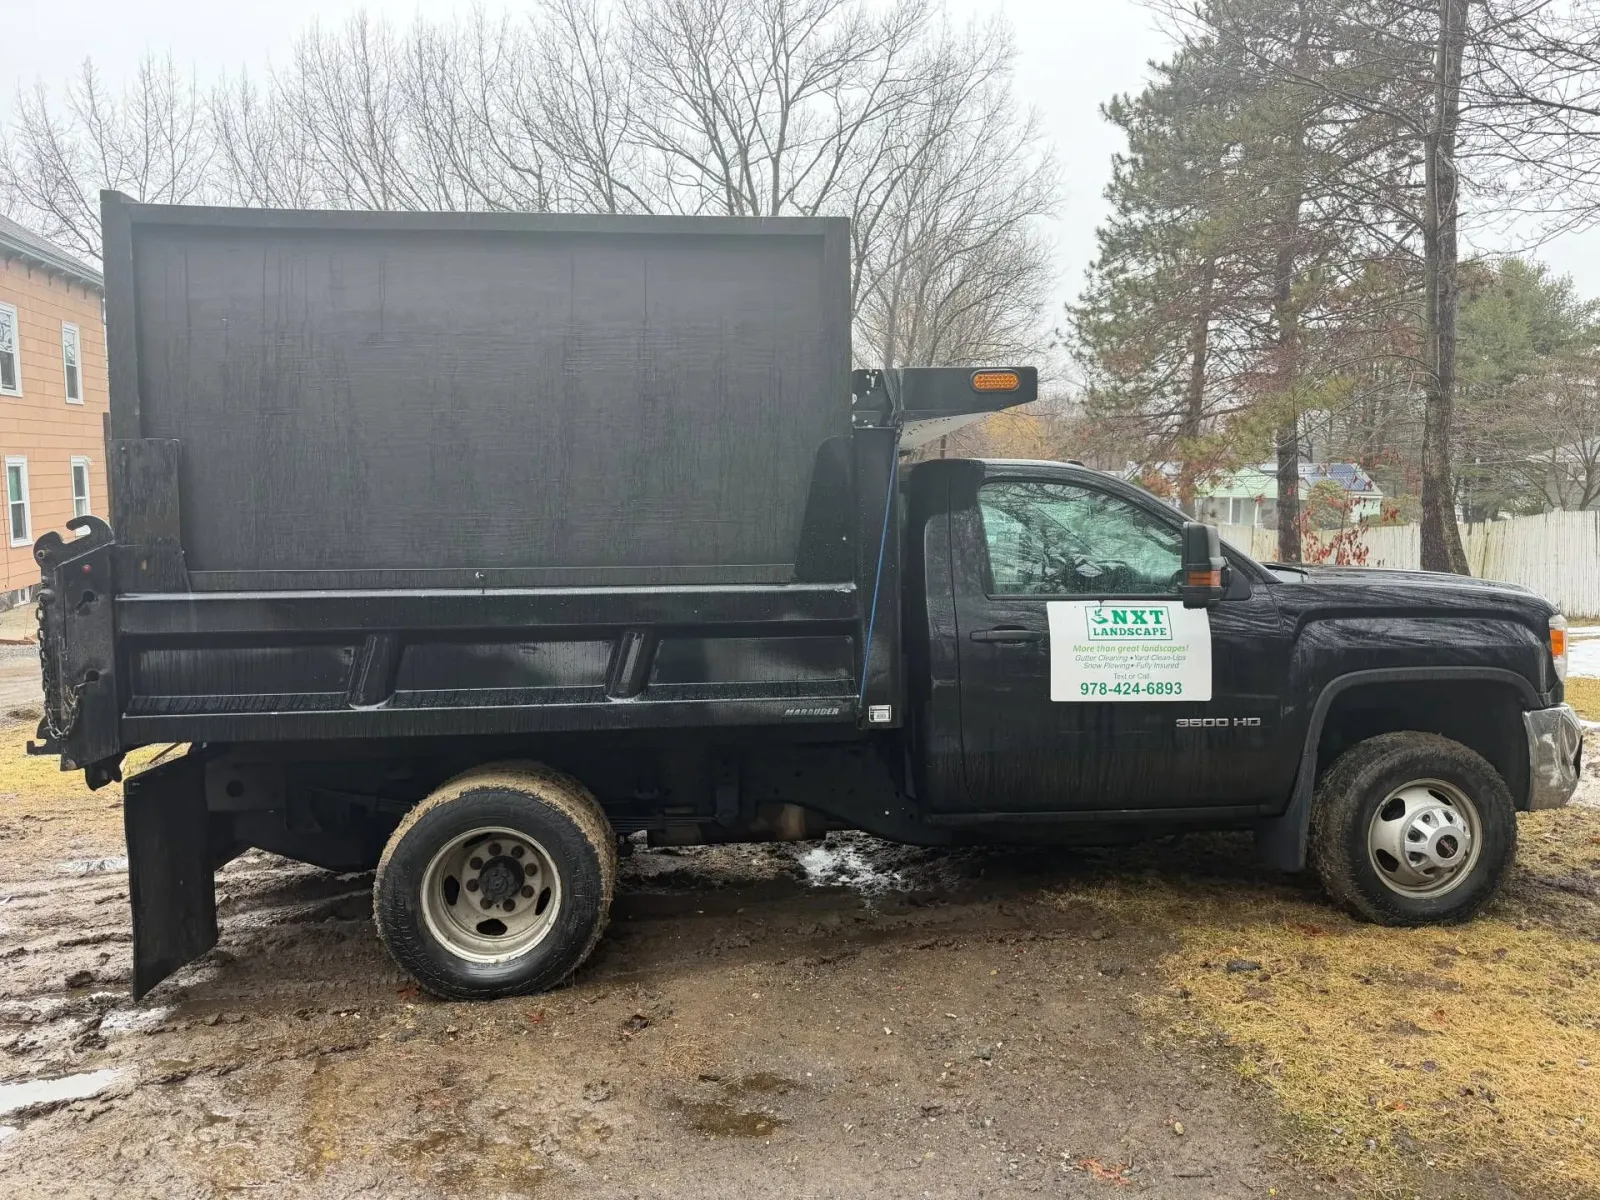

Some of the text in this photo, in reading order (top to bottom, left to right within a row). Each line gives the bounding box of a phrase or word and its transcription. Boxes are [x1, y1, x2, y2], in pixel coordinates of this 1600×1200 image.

[1111, 609, 1164, 625] NXT
[1093, 627, 1167, 636] LANDSCAPE
[1117, 645, 1140, 654] great
[1141, 644, 1189, 654] landscapes!
[1075, 654, 1187, 663] Gutter Cleaning Yard Clean-Ups
[1103, 662, 1131, 670] Plowing
[1136, 662, 1152, 670] Fully
[1080, 682, 1183, 696] 978-424-6893
[785, 707, 839, 715] MARAUDER
[1176, 718, 1260, 727] 3500 HD
